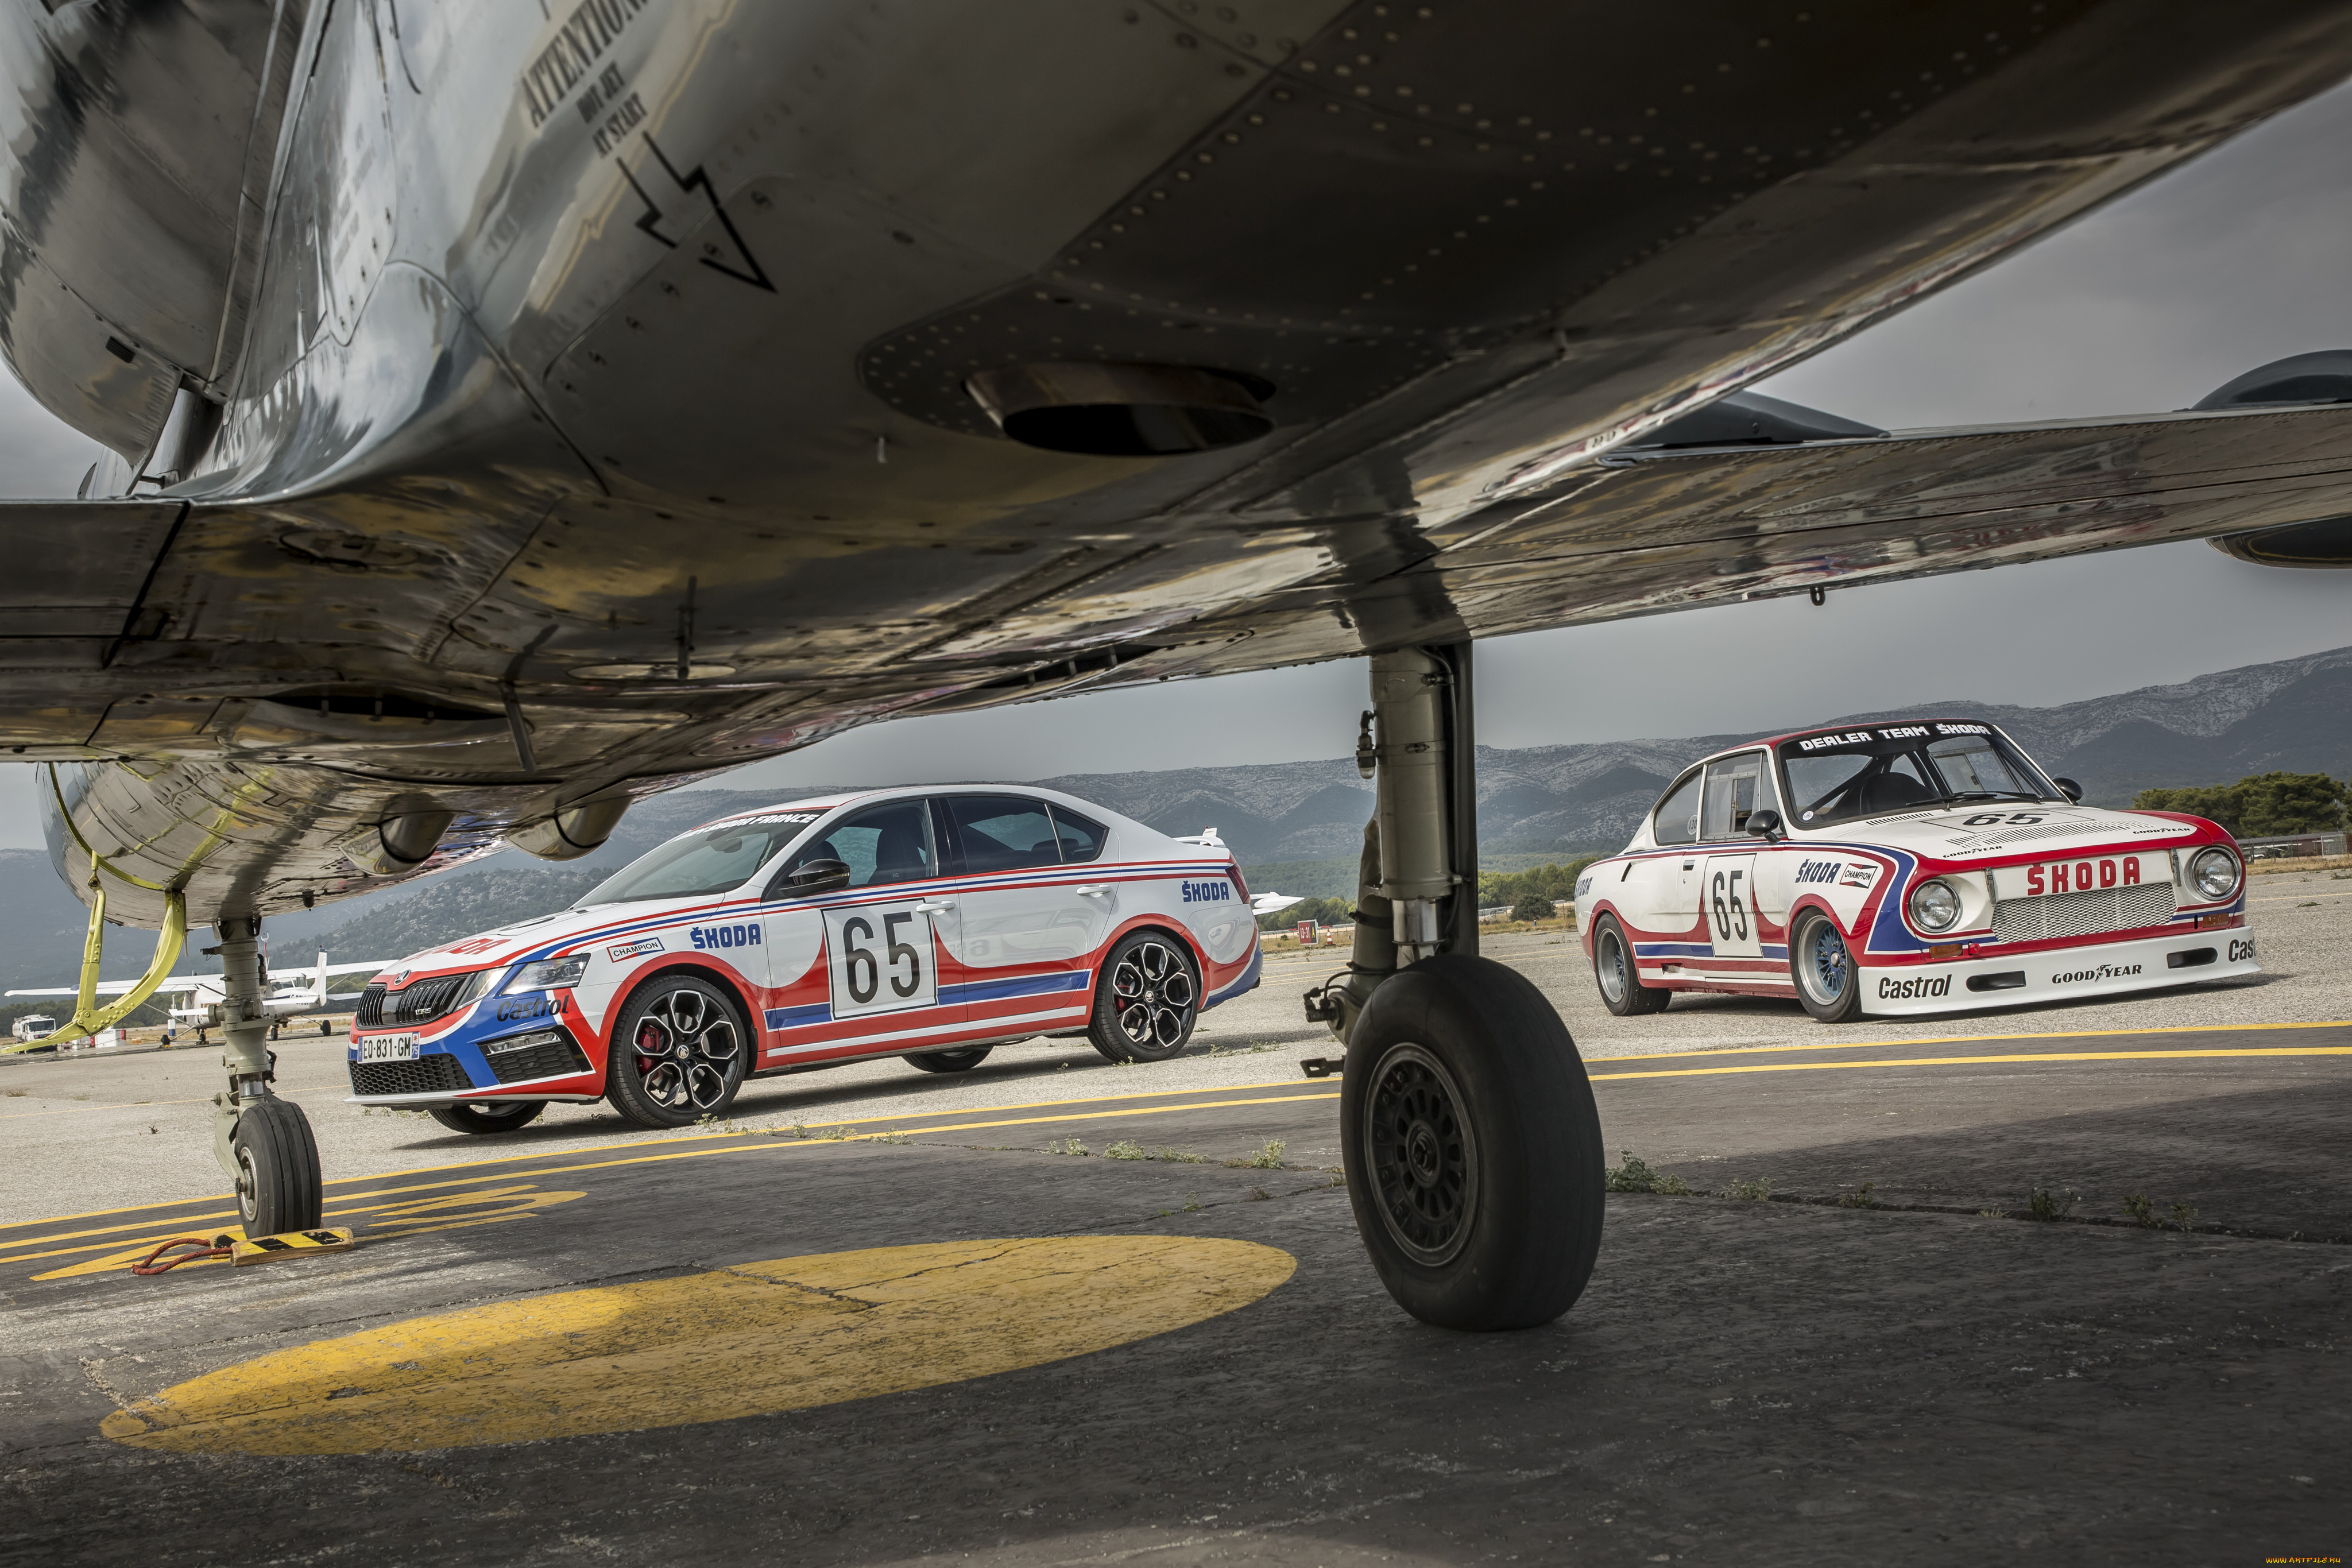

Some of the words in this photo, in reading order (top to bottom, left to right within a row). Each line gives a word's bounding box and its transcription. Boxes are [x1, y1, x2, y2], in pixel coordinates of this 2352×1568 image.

[592, 127, 613, 158] AT
[605, 91, 647, 143] START
[1799, 731, 1873, 750] DEALER
[1878, 726, 1930, 740] TEAM
[1936, 723, 1991, 735] ŠKODA
[749, 814, 820, 825] FRANCE
[1963, 814, 2050, 826] 65
[1795, 858, 1842, 883] ŠKODA
[1844, 870, 1872, 880] CHAMPION
[2028, 856, 2140, 896] ŠKODA
[1182, 880, 1229, 903] ŠKODA
[1712, 870, 1747, 942] 65
[690, 923, 761, 949] ŠKODA
[1312, 926, 1316, 938] A
[613, 942, 659, 957] CHAMPION
[844, 911, 920, 1004] 65
[1878, 974, 1952, 999] Castrol
[497, 995, 569, 1021] Castrol
[363, 1037, 411, 1059] EQ-831-GM
[412, 1046, 419, 1055] 75
